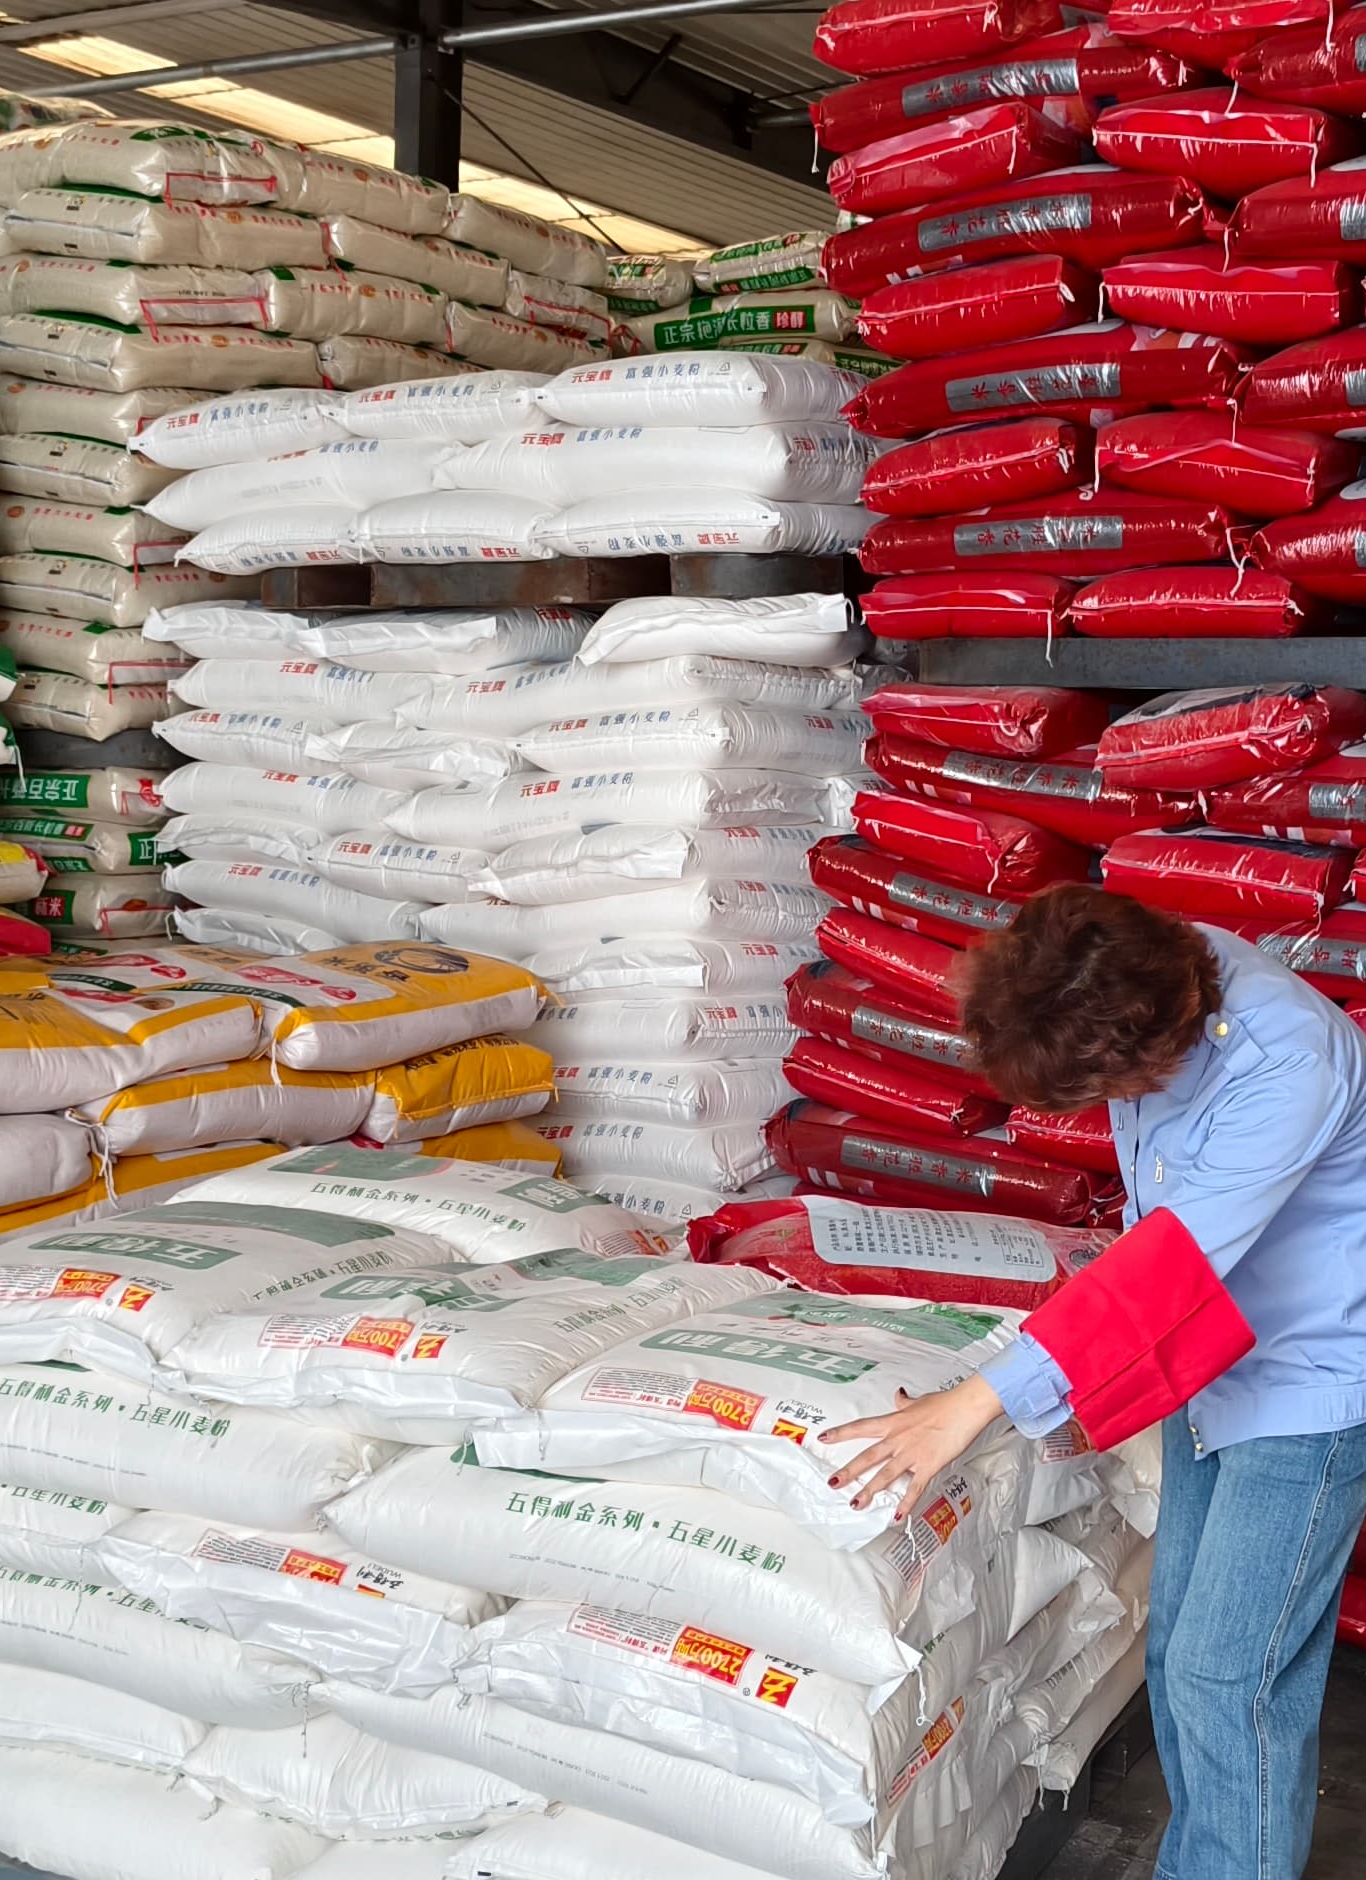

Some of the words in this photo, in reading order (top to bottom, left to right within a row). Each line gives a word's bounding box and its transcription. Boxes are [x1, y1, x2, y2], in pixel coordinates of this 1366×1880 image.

[571, 369, 612, 384] 元宝牌
[626, 362, 700, 378] 富强小麦粉
[358, 390, 396, 403] 元宝牌
[166, 413, 199, 429] 元宝牌
[520, 433, 564, 445] 元宝牌
[697, 533, 739, 545] 元宝牌
[481, 547, 519, 558] 元宝牌
[280, 662, 318, 675] 元宝牌
[466, 681, 506, 694] 元宝牌
[548, 718, 588, 732] 元宝牌
[599, 711, 672, 727] 富强小麦粉
[519, 781, 561, 797] 元宝牌
[338, 841, 373, 855] 元宝牌
[588, 1067, 653, 1084] 富强小麦粉
[659, 1331, 859, 1374] 五得利
[673, 1637, 742, 1677] 2700万吨
